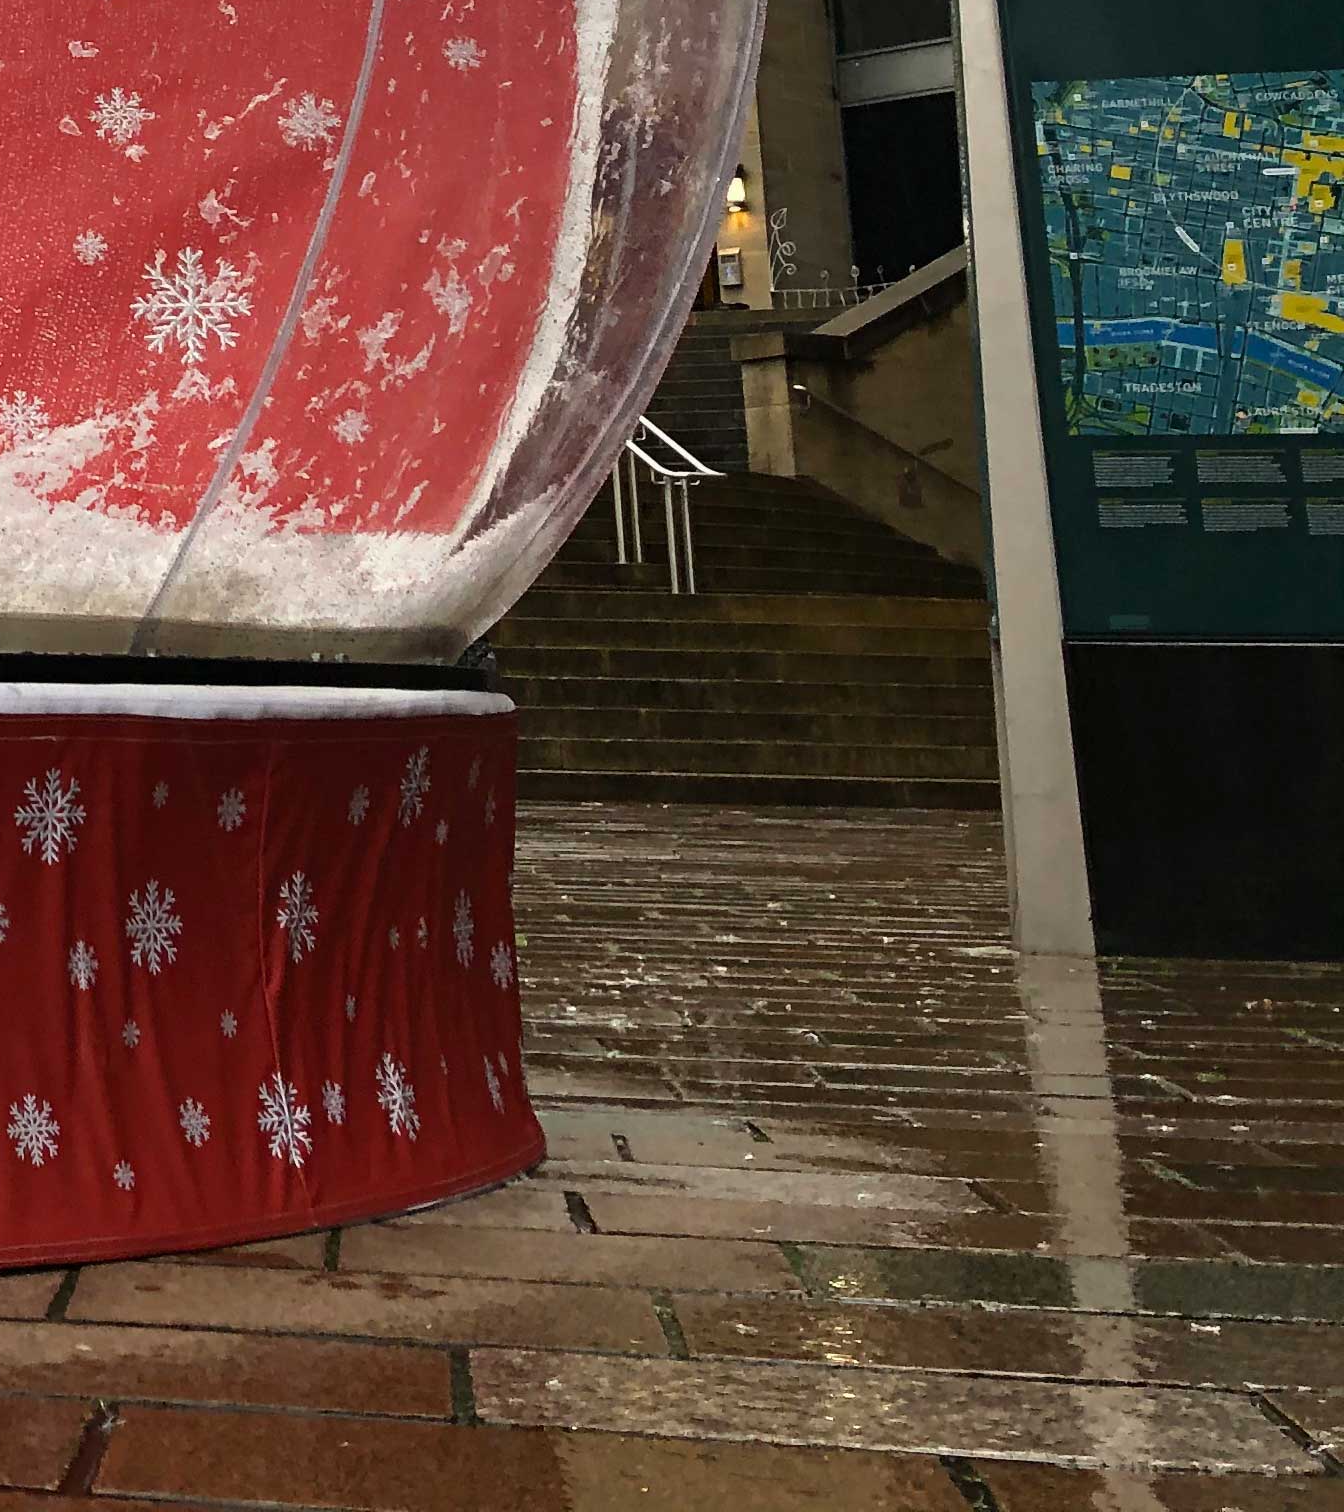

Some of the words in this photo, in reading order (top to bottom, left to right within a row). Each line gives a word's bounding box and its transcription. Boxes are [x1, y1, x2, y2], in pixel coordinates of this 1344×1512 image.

[1255, 89, 1338, 101] COWCADDENS
[1047, 163, 1103, 174] CHARING
[1242, 206, 1272, 216] CITY
[1243, 217, 1299, 229] CENTRE
[1124, 382, 1201, 393] TRADESTON
